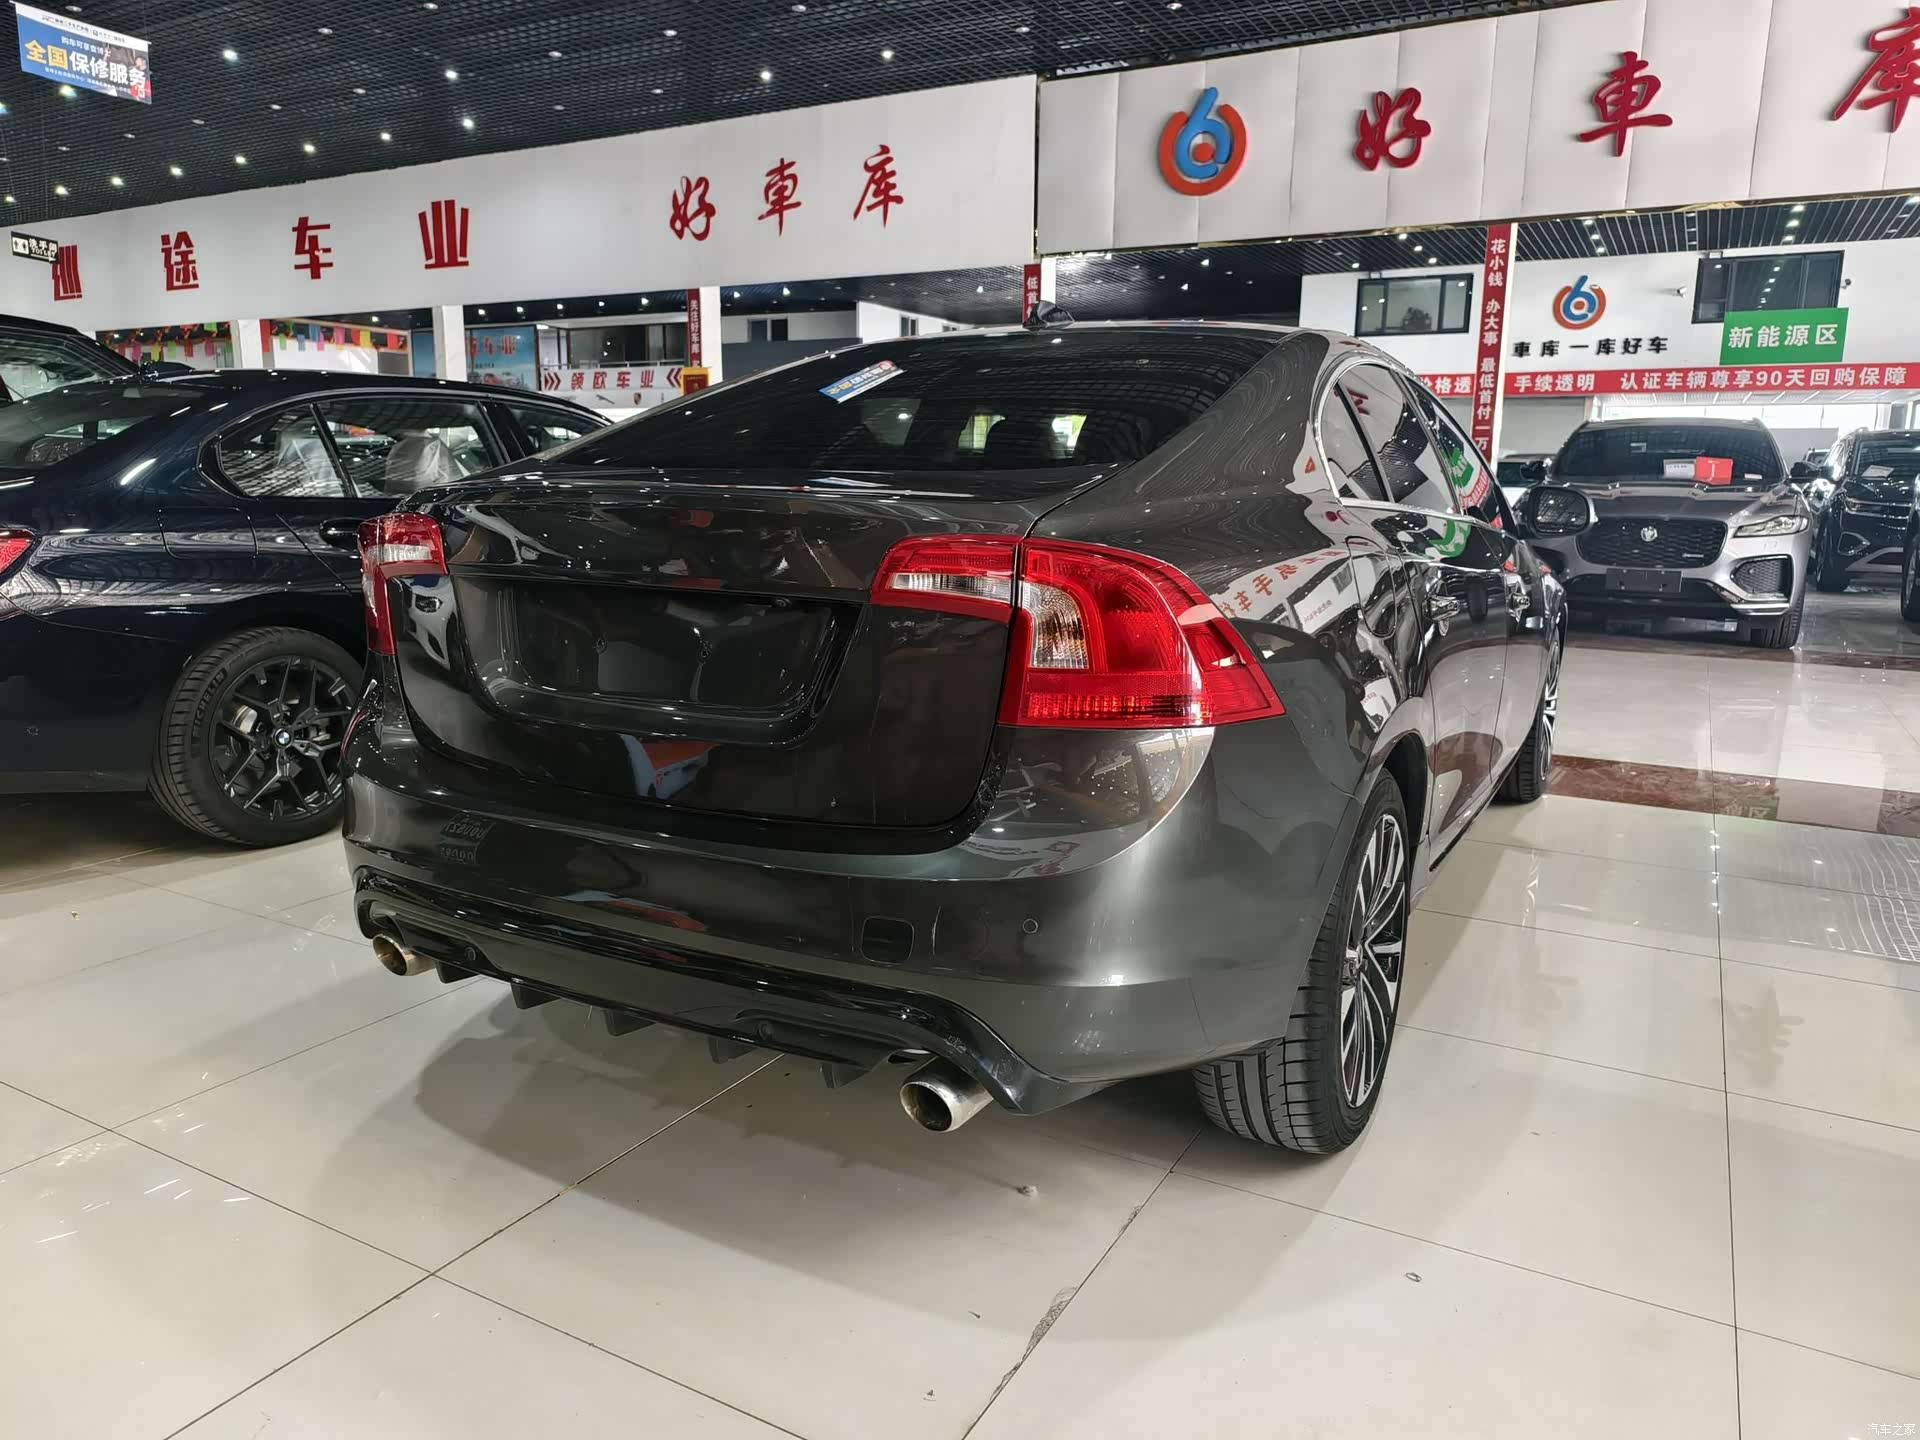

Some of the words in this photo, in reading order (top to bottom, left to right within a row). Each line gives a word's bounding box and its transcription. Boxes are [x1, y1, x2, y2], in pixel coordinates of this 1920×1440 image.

[24, 40, 147, 89] 全国保修服务
[1487, 238, 1507, 287] 花小钱
[1482, 299, 1501, 346] 办大事
[1727, 323, 1839, 350] 新能源区
[570, 369, 655, 391] 领欧车业
[1513, 372, 1596, 393] 手续透明
[1619, 366, 1908, 391] 认证车辆尊享90天回购保障
[1475, 356, 1497, 451] 最低首付一万
